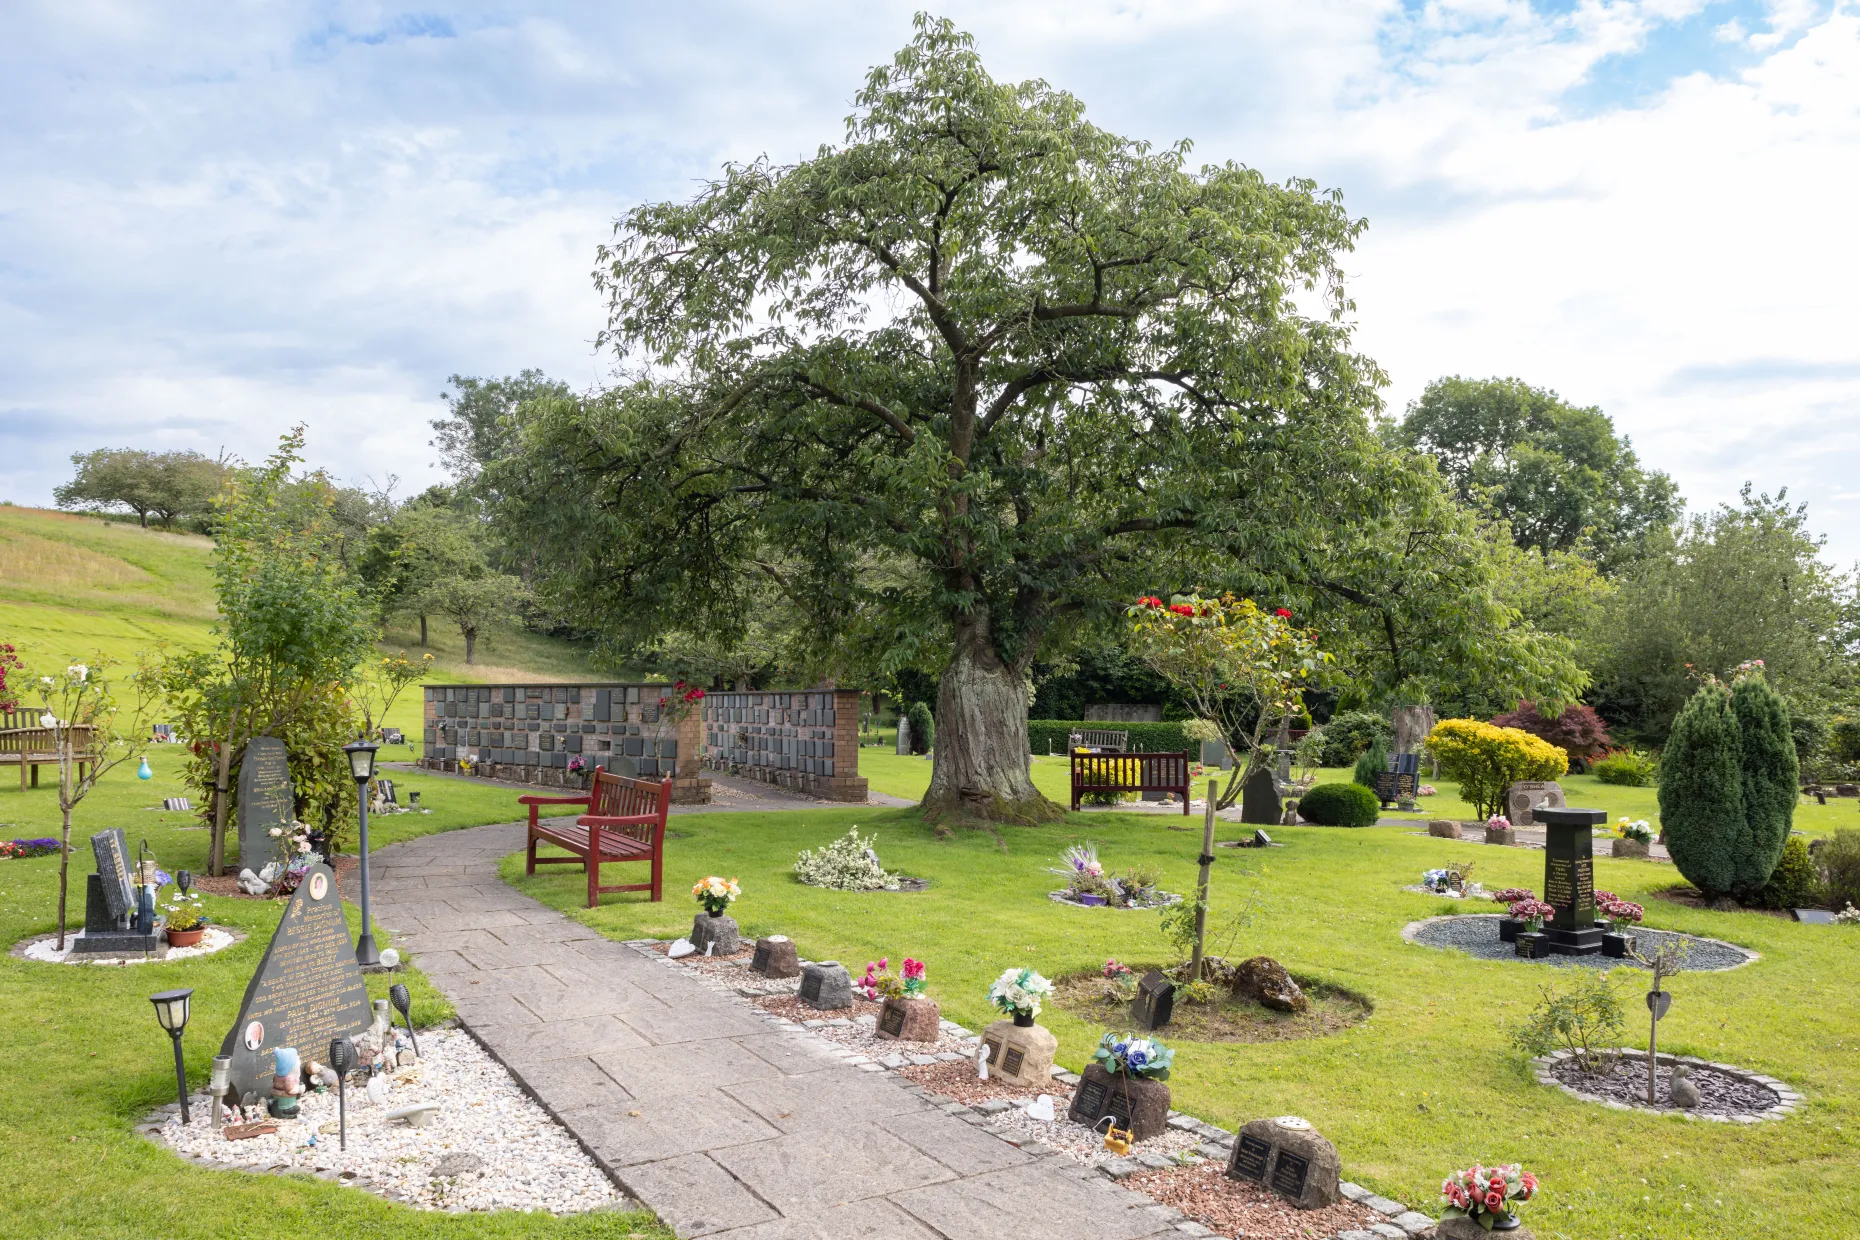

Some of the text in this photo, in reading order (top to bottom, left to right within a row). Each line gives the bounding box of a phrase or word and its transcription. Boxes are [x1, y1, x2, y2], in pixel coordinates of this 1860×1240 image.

[307, 904, 332, 913] Precious
[304, 912, 332, 922] Memories
[287, 918, 341, 935] BESSIE DIGNUM
[317, 955, 336, 966] BECKY
[299, 988, 316, 998] TAKES
[287, 998, 340, 1019] PAUL DIGNUM
[261, 1047, 275, 1056] BAC
